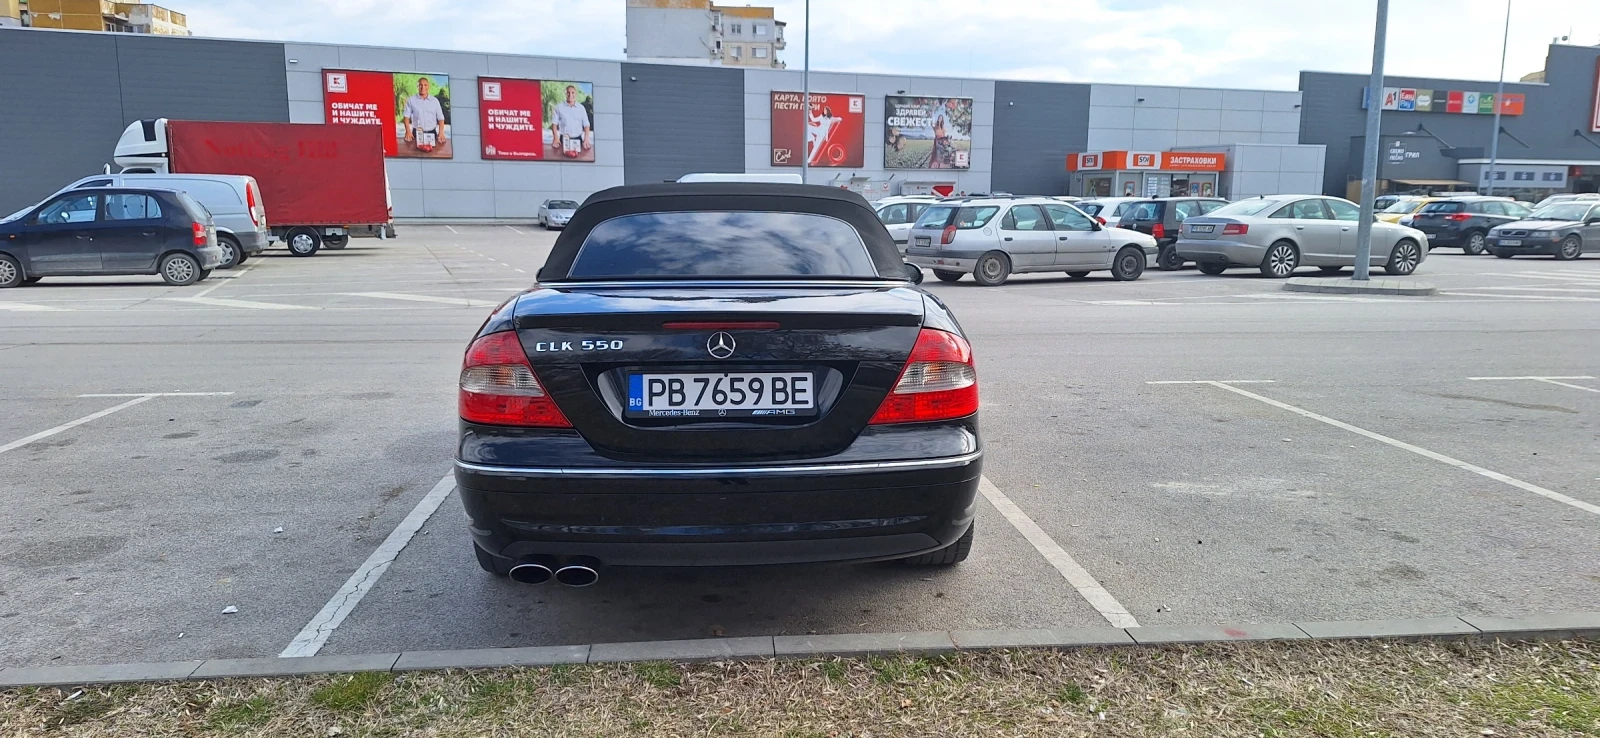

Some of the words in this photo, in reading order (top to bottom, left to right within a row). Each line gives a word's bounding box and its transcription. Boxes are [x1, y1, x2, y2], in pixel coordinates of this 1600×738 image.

[774, 93, 801, 103] КАРТА,
[1385, 91, 1397, 106] A1
[331, 102, 364, 110] ОБИЧАТ
[774, 102, 799, 110] ПЕСТИ
[800, 103, 820, 111] ПРИ
[340, 110, 377, 118] НАШИТЕ,
[488, 108, 518, 117] ОБИЧАТ
[520, 109, 532, 117] МЕ
[495, 116, 531, 125] НАШИТЕ,
[495, 123, 536, 132] ЧУЖДИТЕ.
[1170, 156, 1217, 164] ЗАСТРАХОВКИ
[535, 341, 574, 352] CLK
[581, 340, 623, 351] 550
[648, 378, 686, 407] PB
[693, 377, 765, 406] 7659
[771, 376, 809, 405] BE
[629, 397, 642, 407] BG
